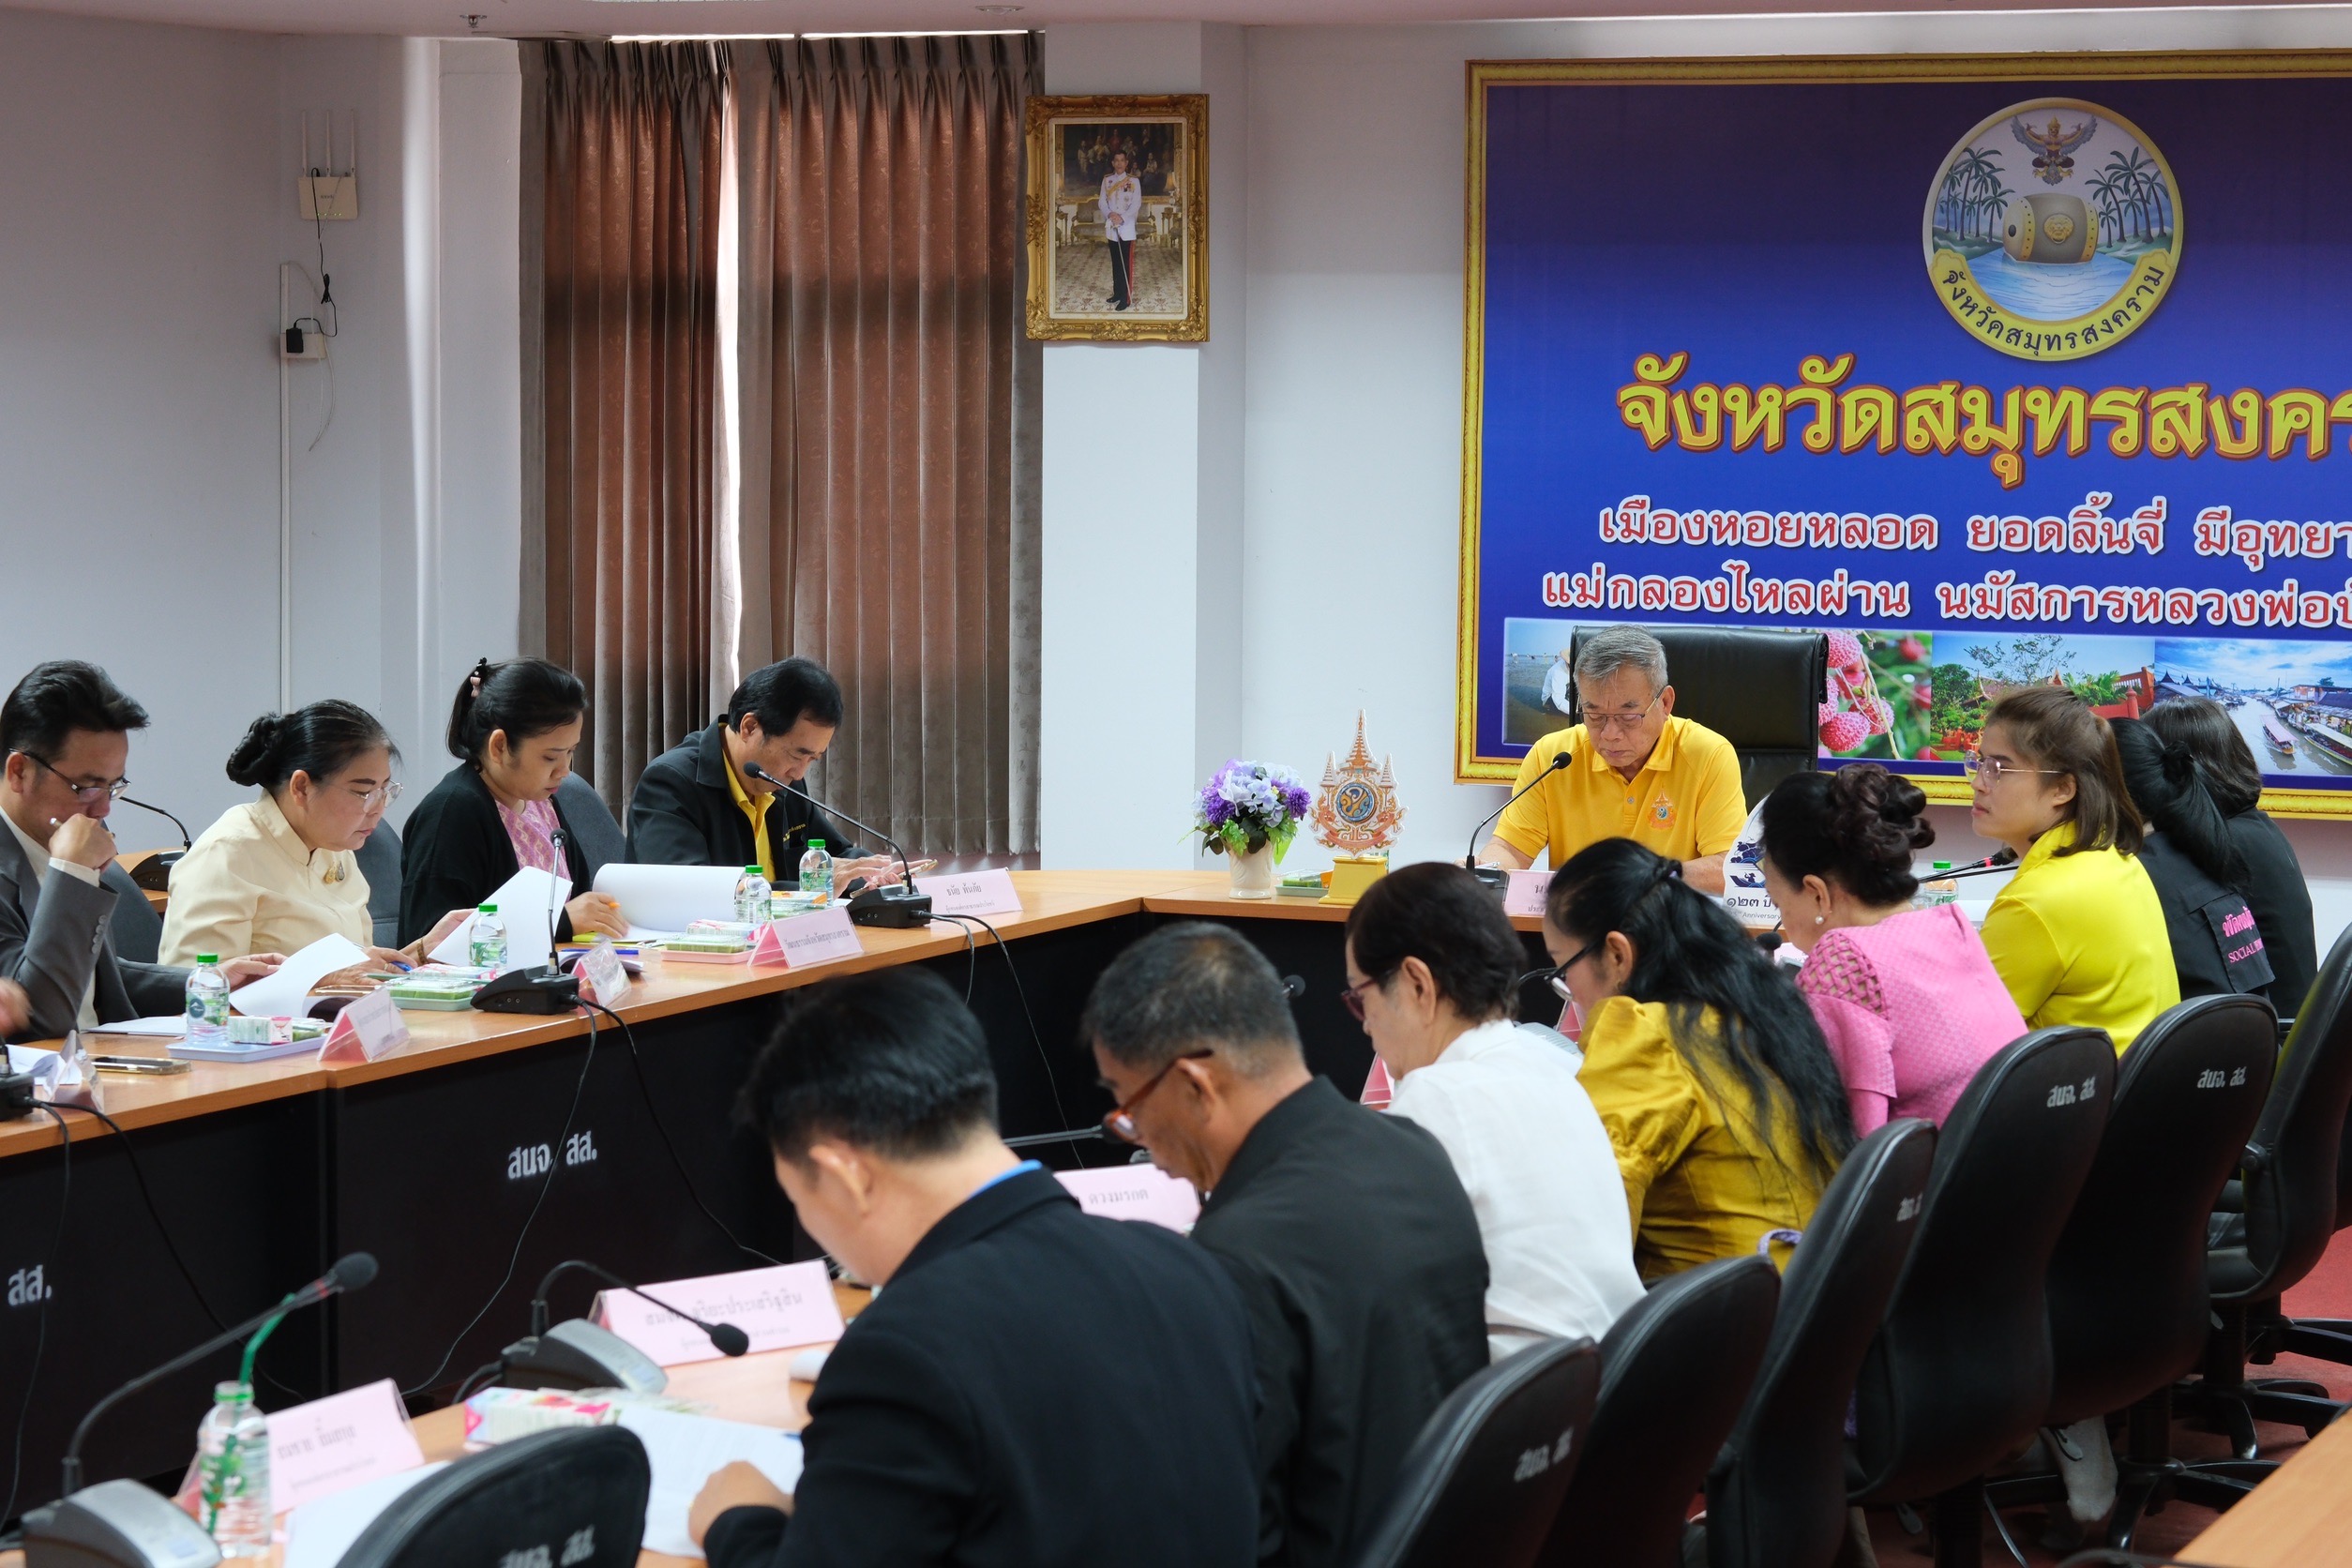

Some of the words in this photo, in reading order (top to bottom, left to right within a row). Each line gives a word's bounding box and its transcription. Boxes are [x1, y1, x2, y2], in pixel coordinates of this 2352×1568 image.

[1942, 265, 2165, 357] จังหวัดสมุทรสงคราม
[1599, 494, 1938, 550] เมืองหอยหลอด
[1967, 490, 2166, 554] ยอดลิ้นจี่
[1543, 559, 1910, 617] แม่กลองไหลผ่าน
[1935, 569, 2352, 628] นมัสการหลวงพ่อบ
[1742, 912, 1782, 921] Anniversary
[2228, 942, 2256, 963] SOCIAL
[565, 1130, 598, 1166] สส.
[8, 1264, 53, 1306] สส.
